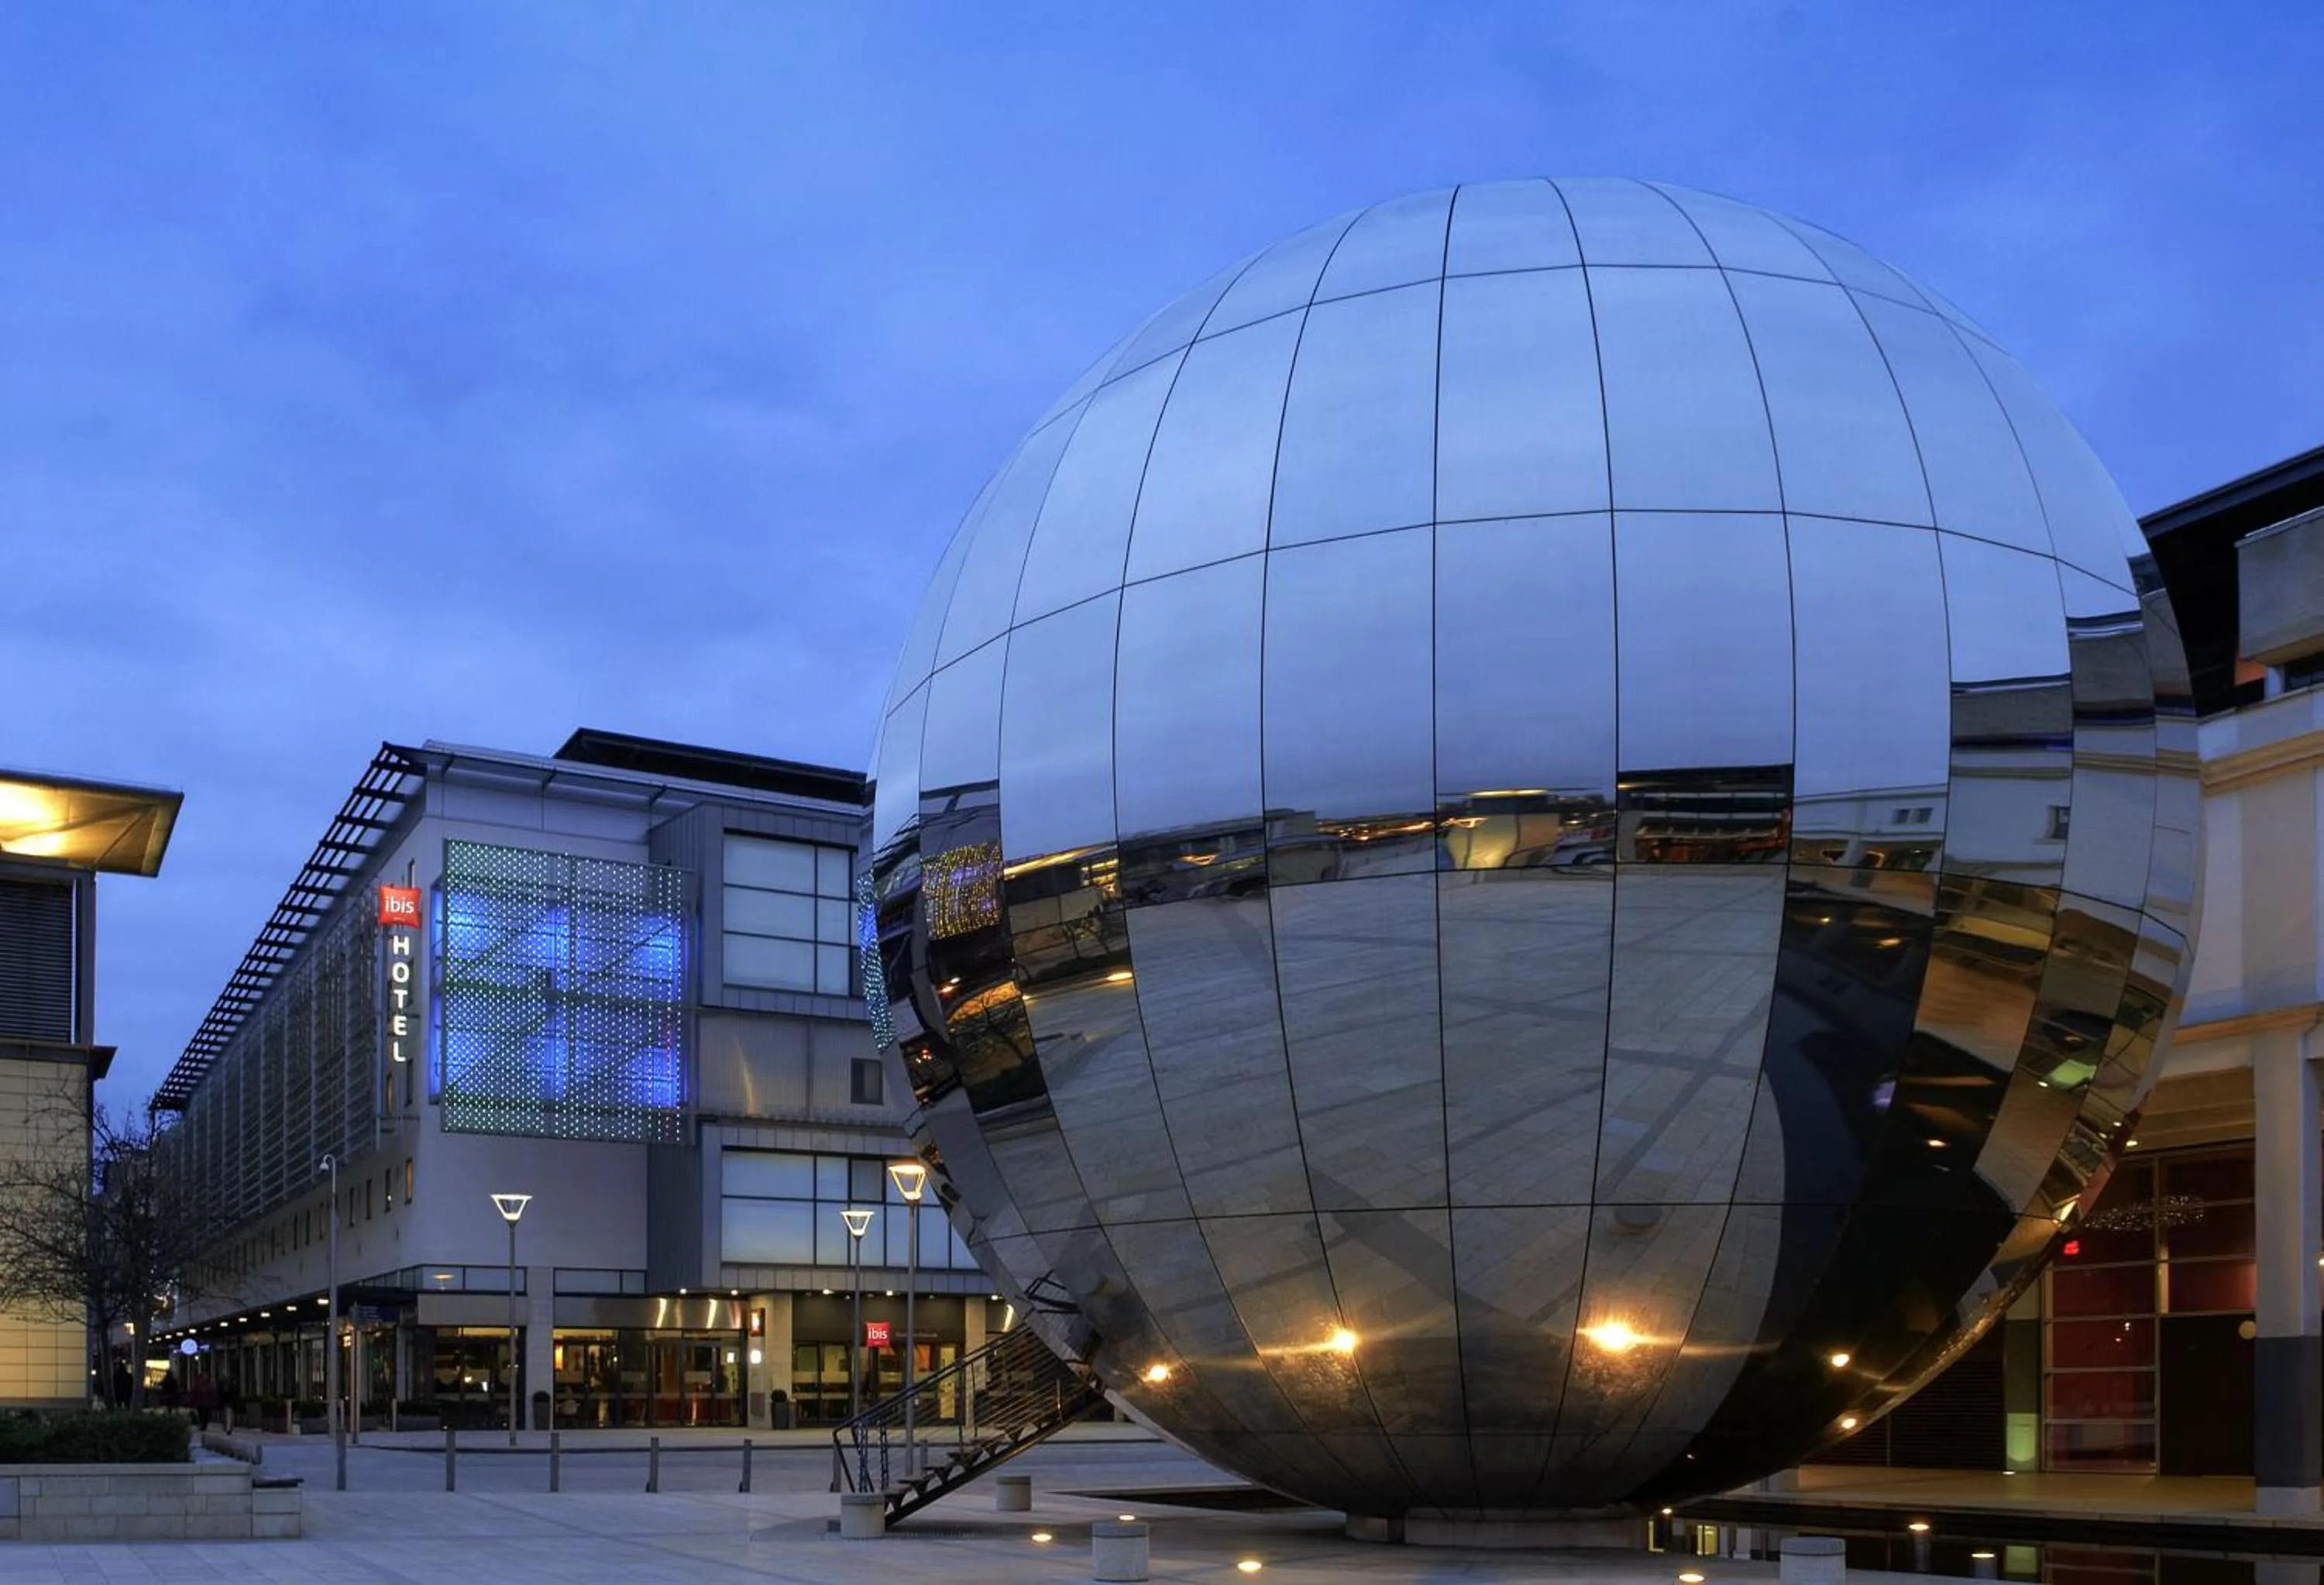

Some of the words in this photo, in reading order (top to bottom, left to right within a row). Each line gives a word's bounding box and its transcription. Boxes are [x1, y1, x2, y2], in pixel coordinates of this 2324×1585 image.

[384, 895, 414, 914] ibis
[392, 935, 410, 1062] HOTEL
[868, 1327, 888, 1339] ibis
